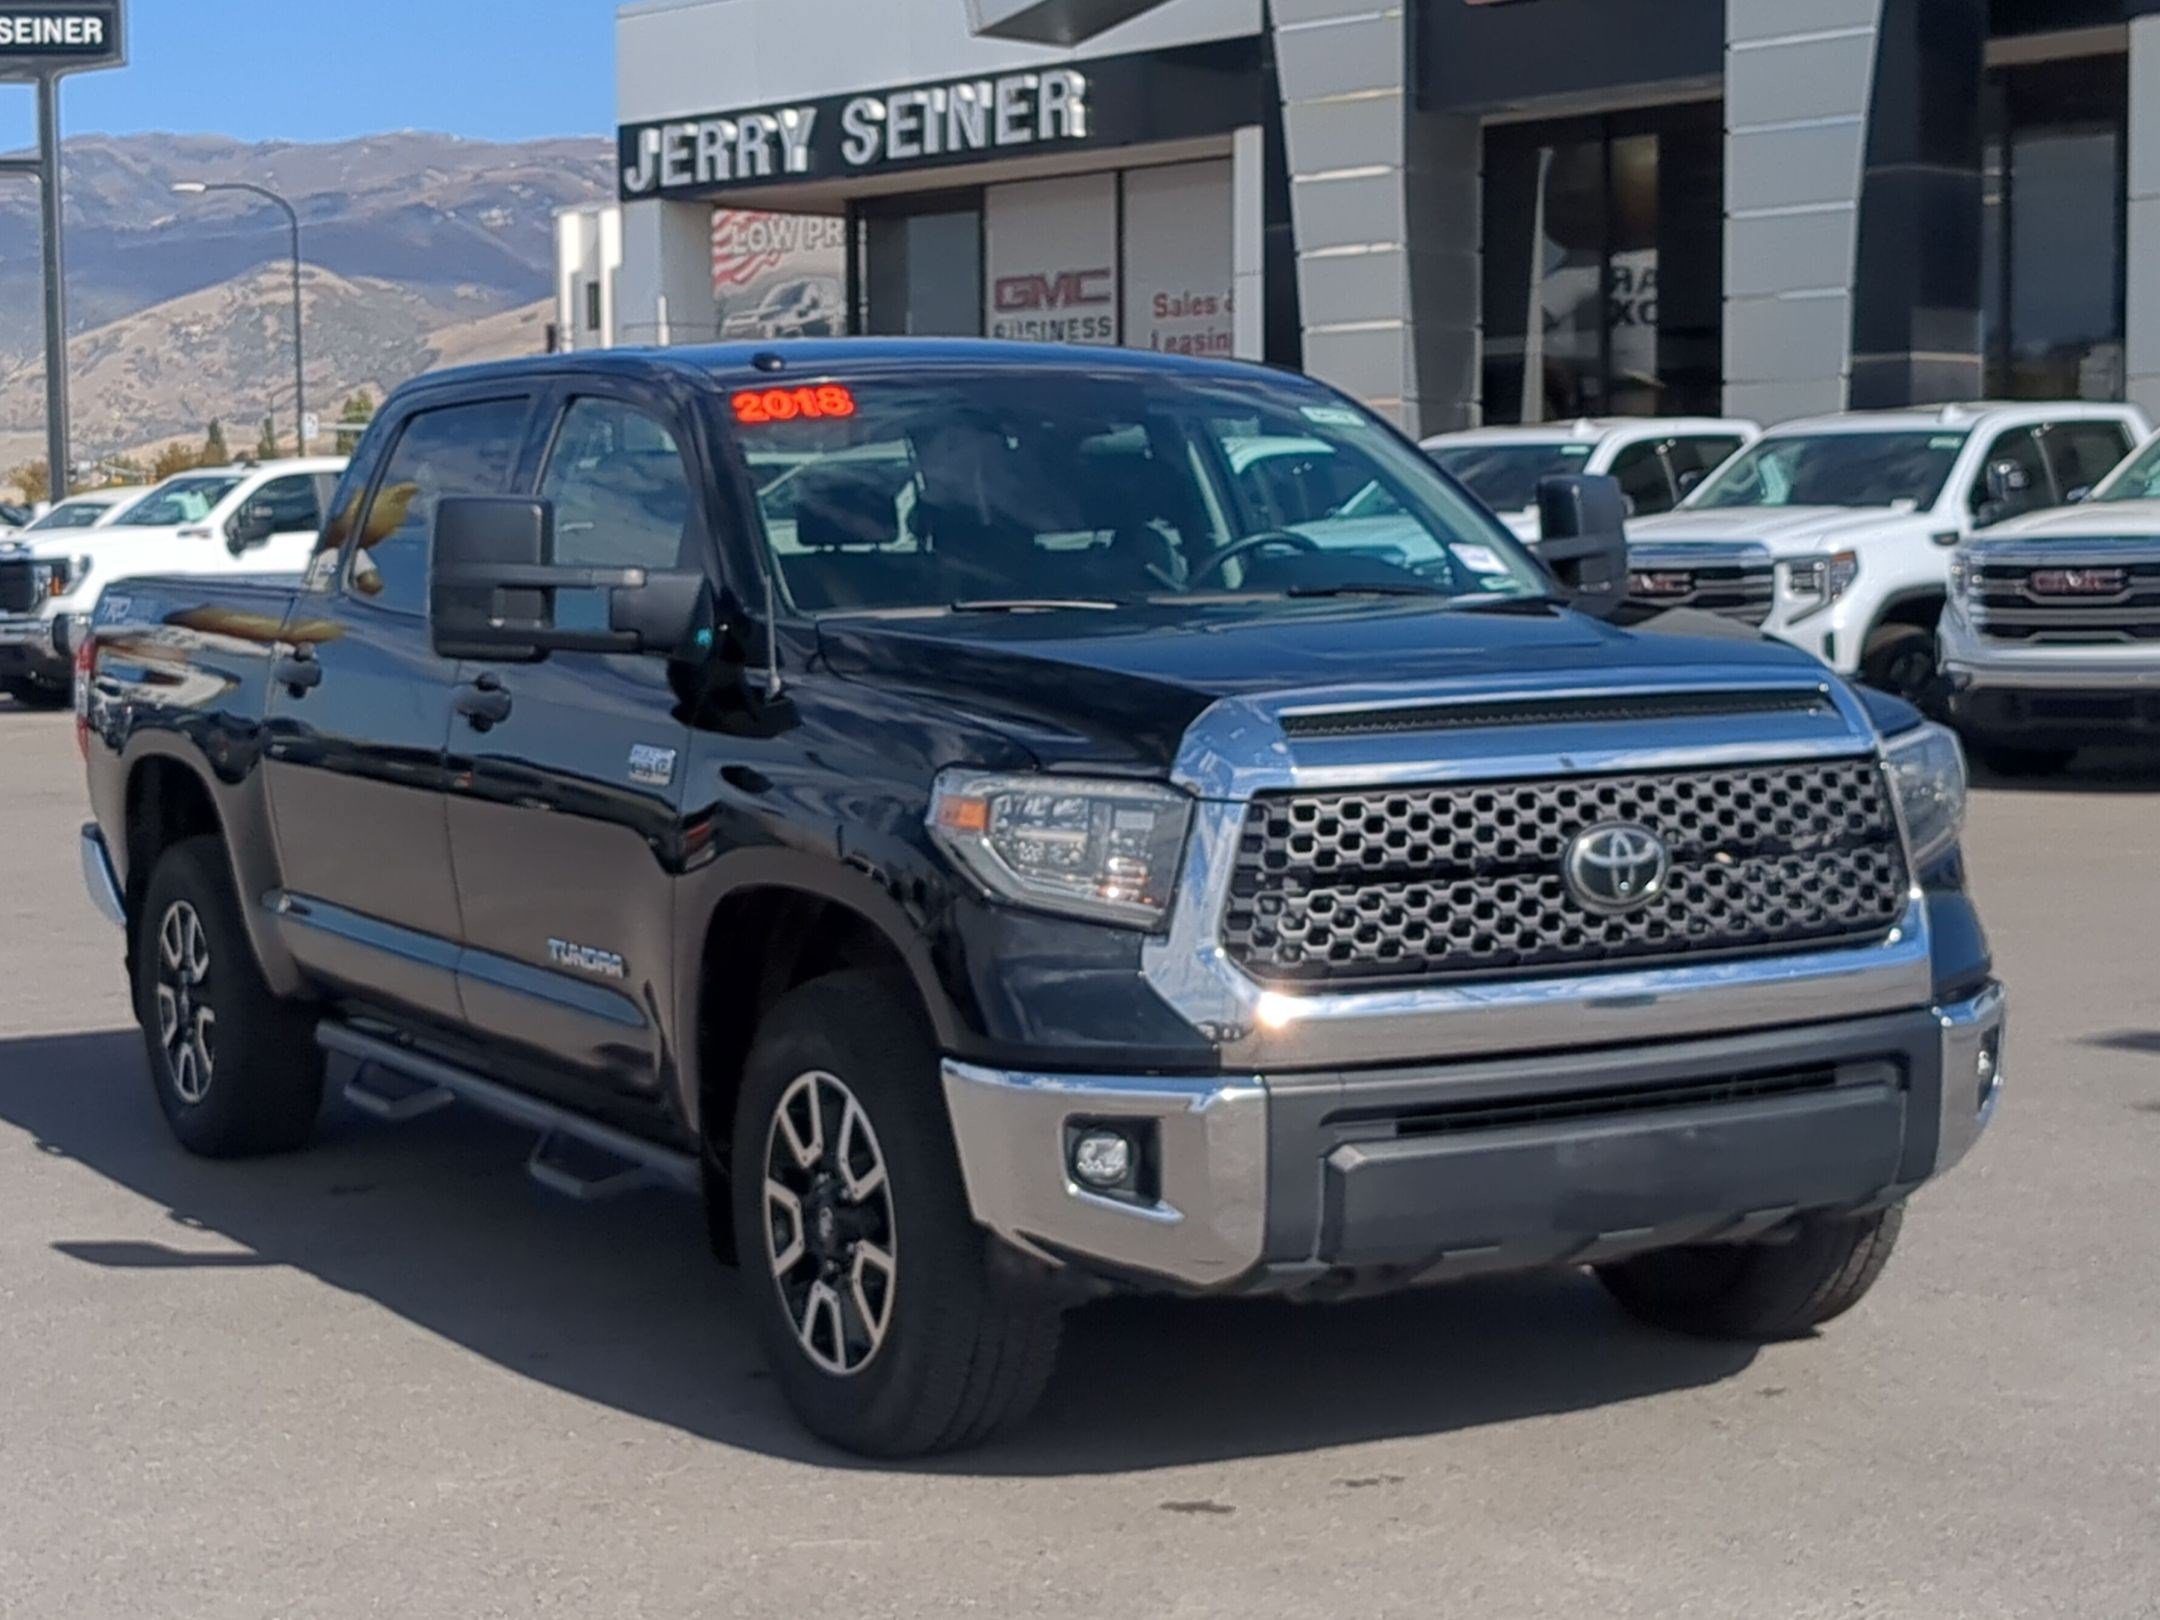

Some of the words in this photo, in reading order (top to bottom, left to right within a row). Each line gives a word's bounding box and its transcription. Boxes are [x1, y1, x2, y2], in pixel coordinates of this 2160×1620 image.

[0, 15, 103, 44] SEINER
[624, 107, 817, 193] JERRY
[841, 69, 1087, 165] SEINER
[731, 216, 799, 255] LOW
[995, 267, 1111, 313] GMC
[1153, 290, 1218, 318] Sales
[1151, 327, 1233, 355] Leasin
[731, 383, 855, 423] 2018
[547, 937, 625, 980] TUNDRA
